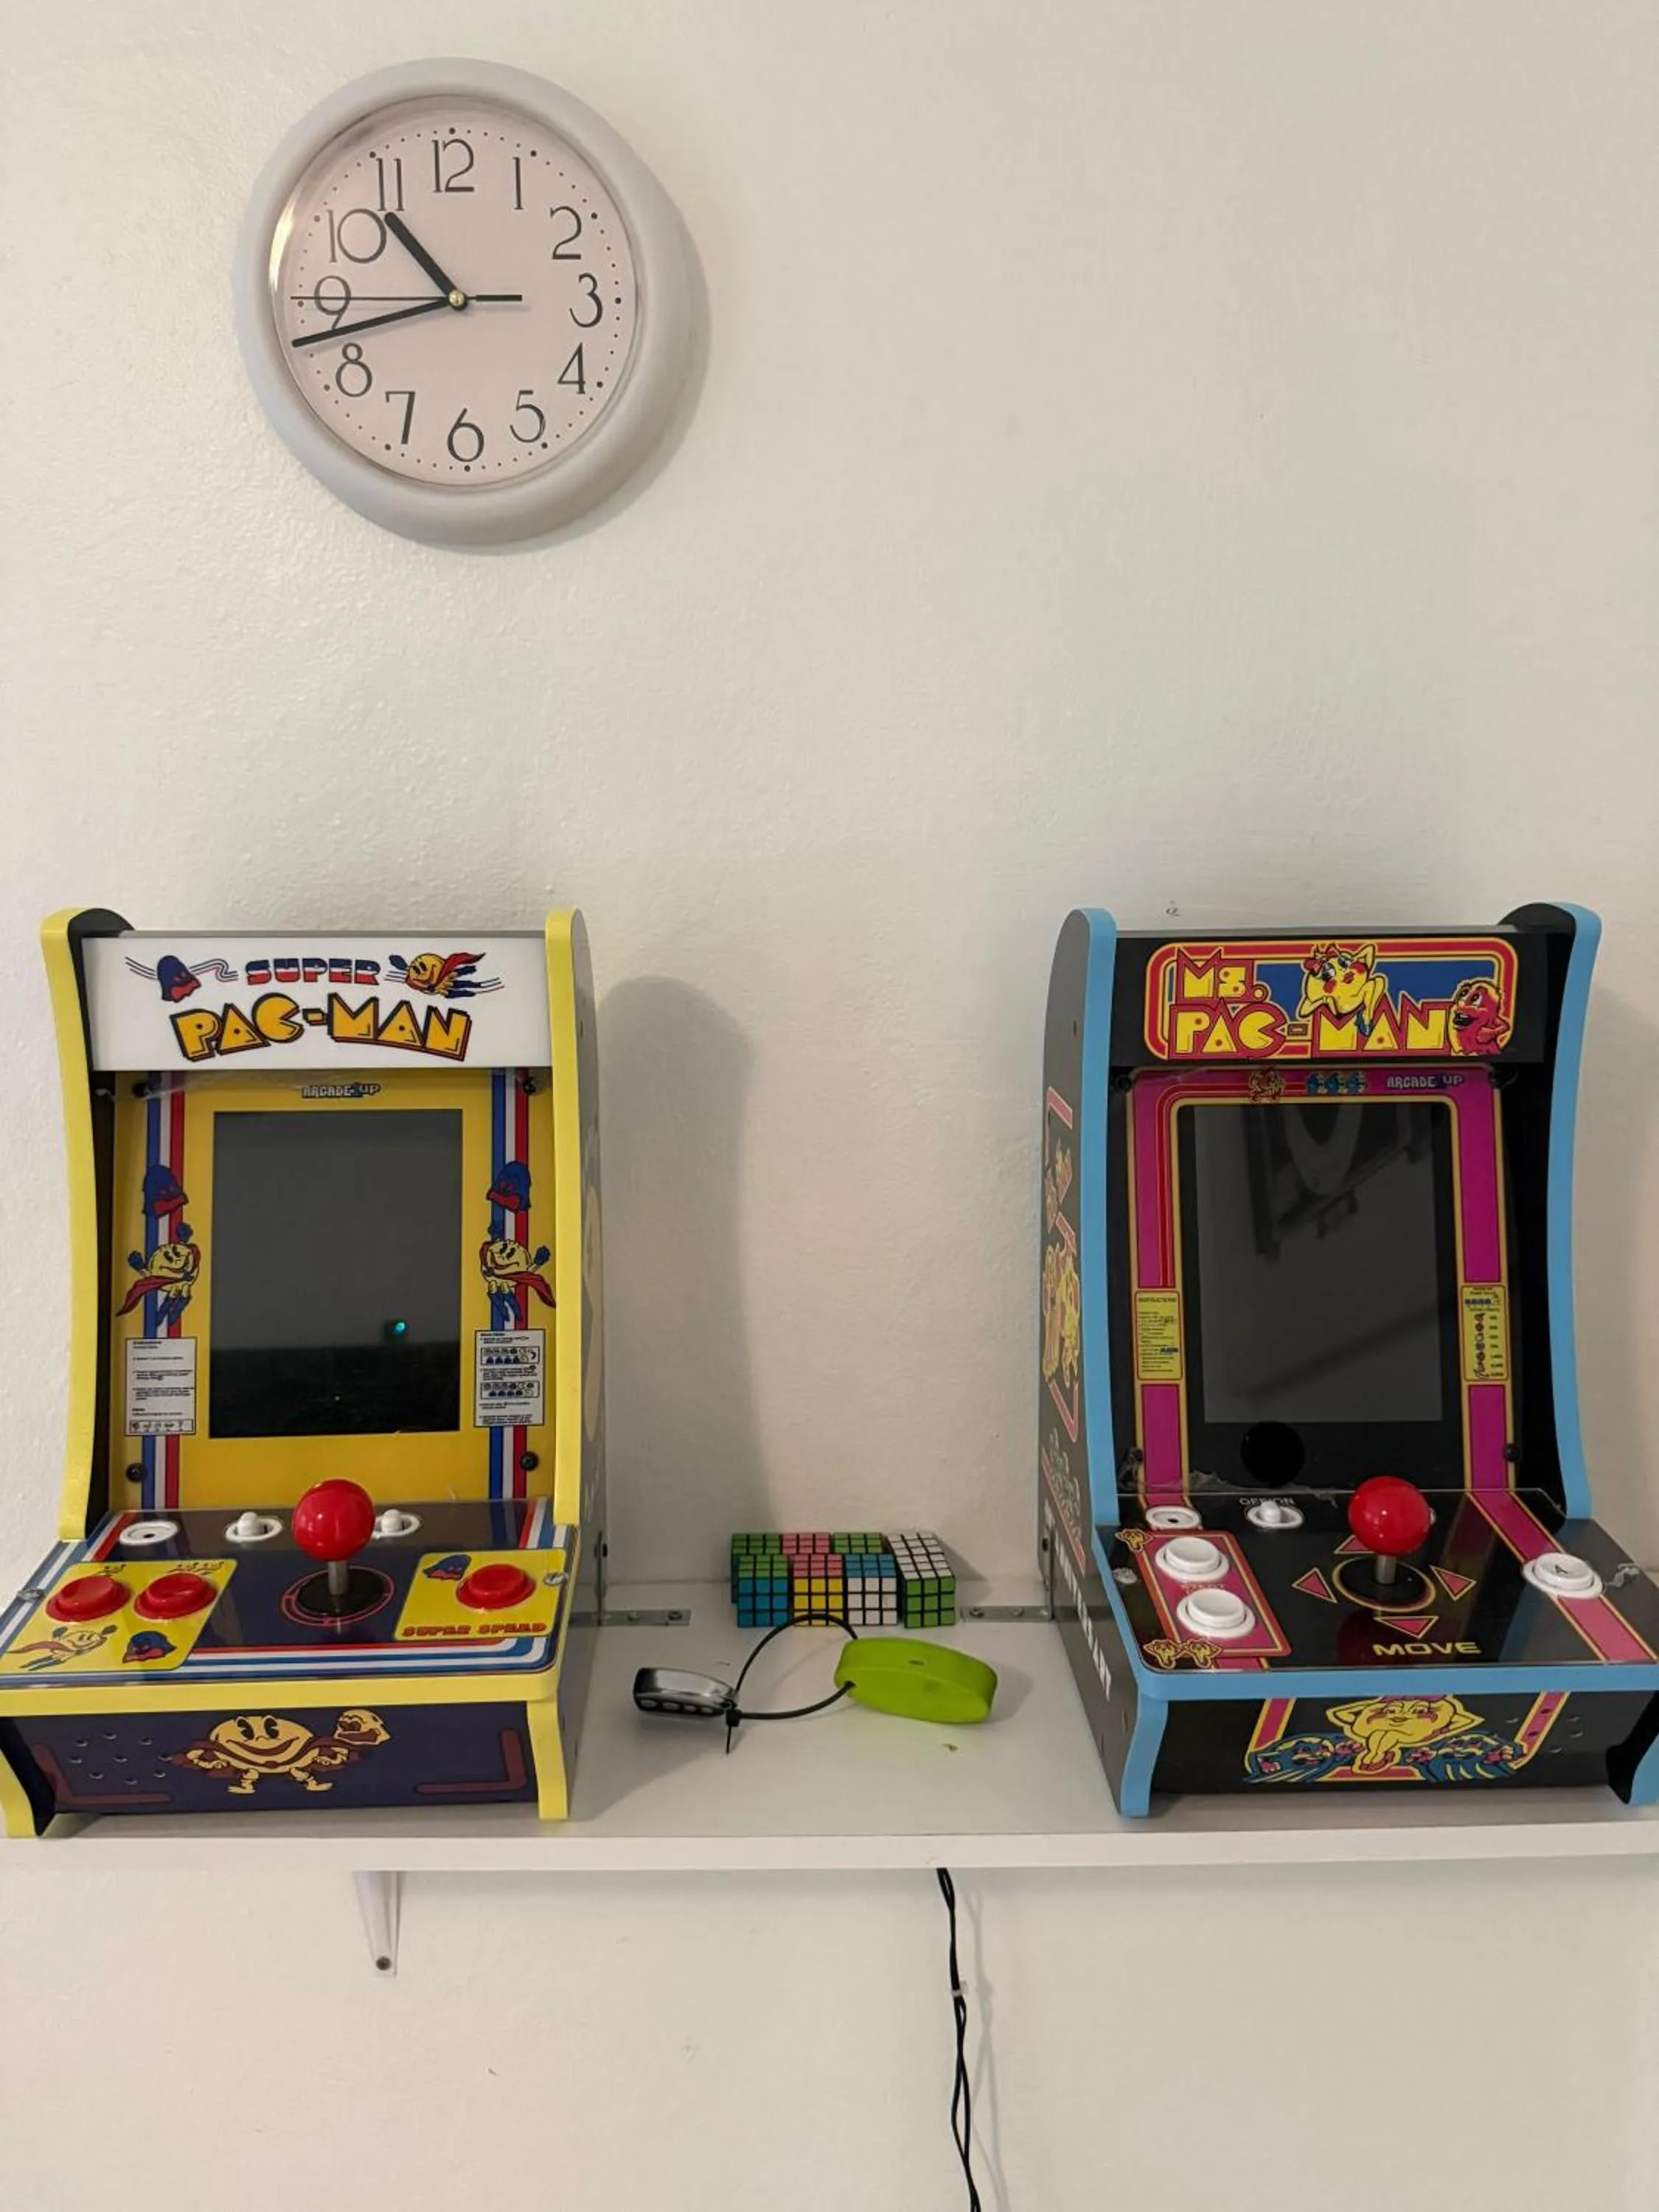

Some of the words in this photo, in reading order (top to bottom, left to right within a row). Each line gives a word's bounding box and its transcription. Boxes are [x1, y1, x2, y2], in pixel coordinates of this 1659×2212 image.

[376, 157, 405, 211] 11
[431, 138, 475, 193] 12
[512, 156, 524, 210] 1
[326, 208, 387, 264] 10
[549, 206, 582, 260] 2
[313, 275, 352, 330] 9
[568, 272, 603, 327] 3
[335, 342, 372, 397] 8
[557, 341, 587, 394] 4
[384, 390, 416, 445] 7
[447, 408, 484, 462] 6
[509, 389, 546, 443] 5
[246, 958, 381, 986] SUPER
[170, 992, 473, 1062] PAC-MAN
[1170, 994, 1451, 1058] PAC-MAN
[1371, 1642, 1482, 1655] MOVE
